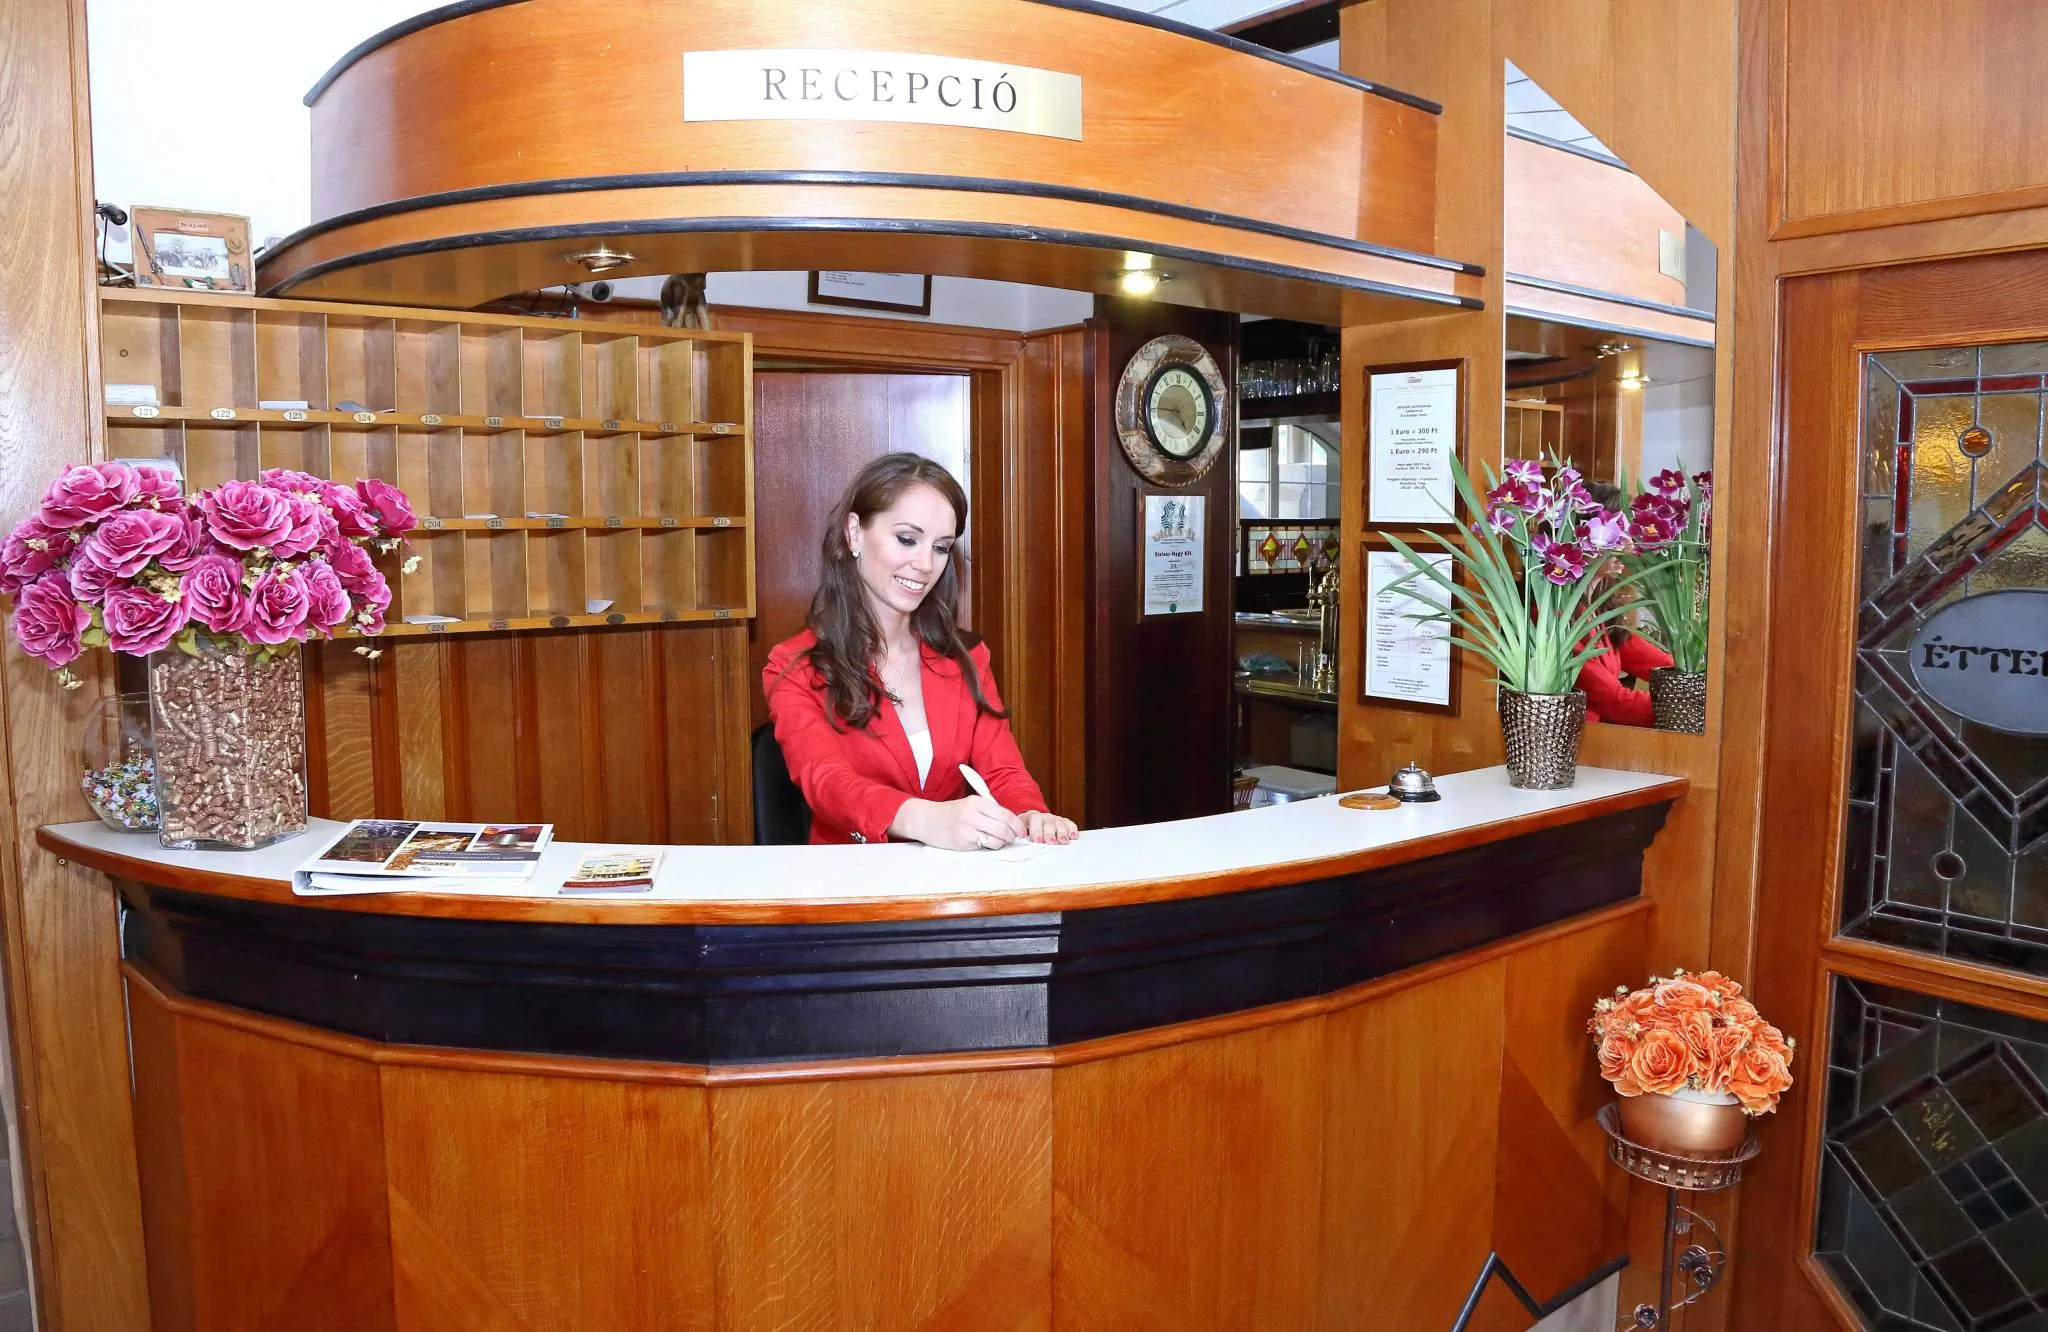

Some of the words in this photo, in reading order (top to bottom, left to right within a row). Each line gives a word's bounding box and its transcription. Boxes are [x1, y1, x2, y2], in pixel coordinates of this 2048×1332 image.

[761, 67, 1017, 113] RECEPCIÓ
[138, 407, 154, 416] 121
[216, 409, 231, 418] 122
[288, 411, 303, 420] 123
[357, 413, 372, 422] 124
[424, 415, 438, 424] 125
